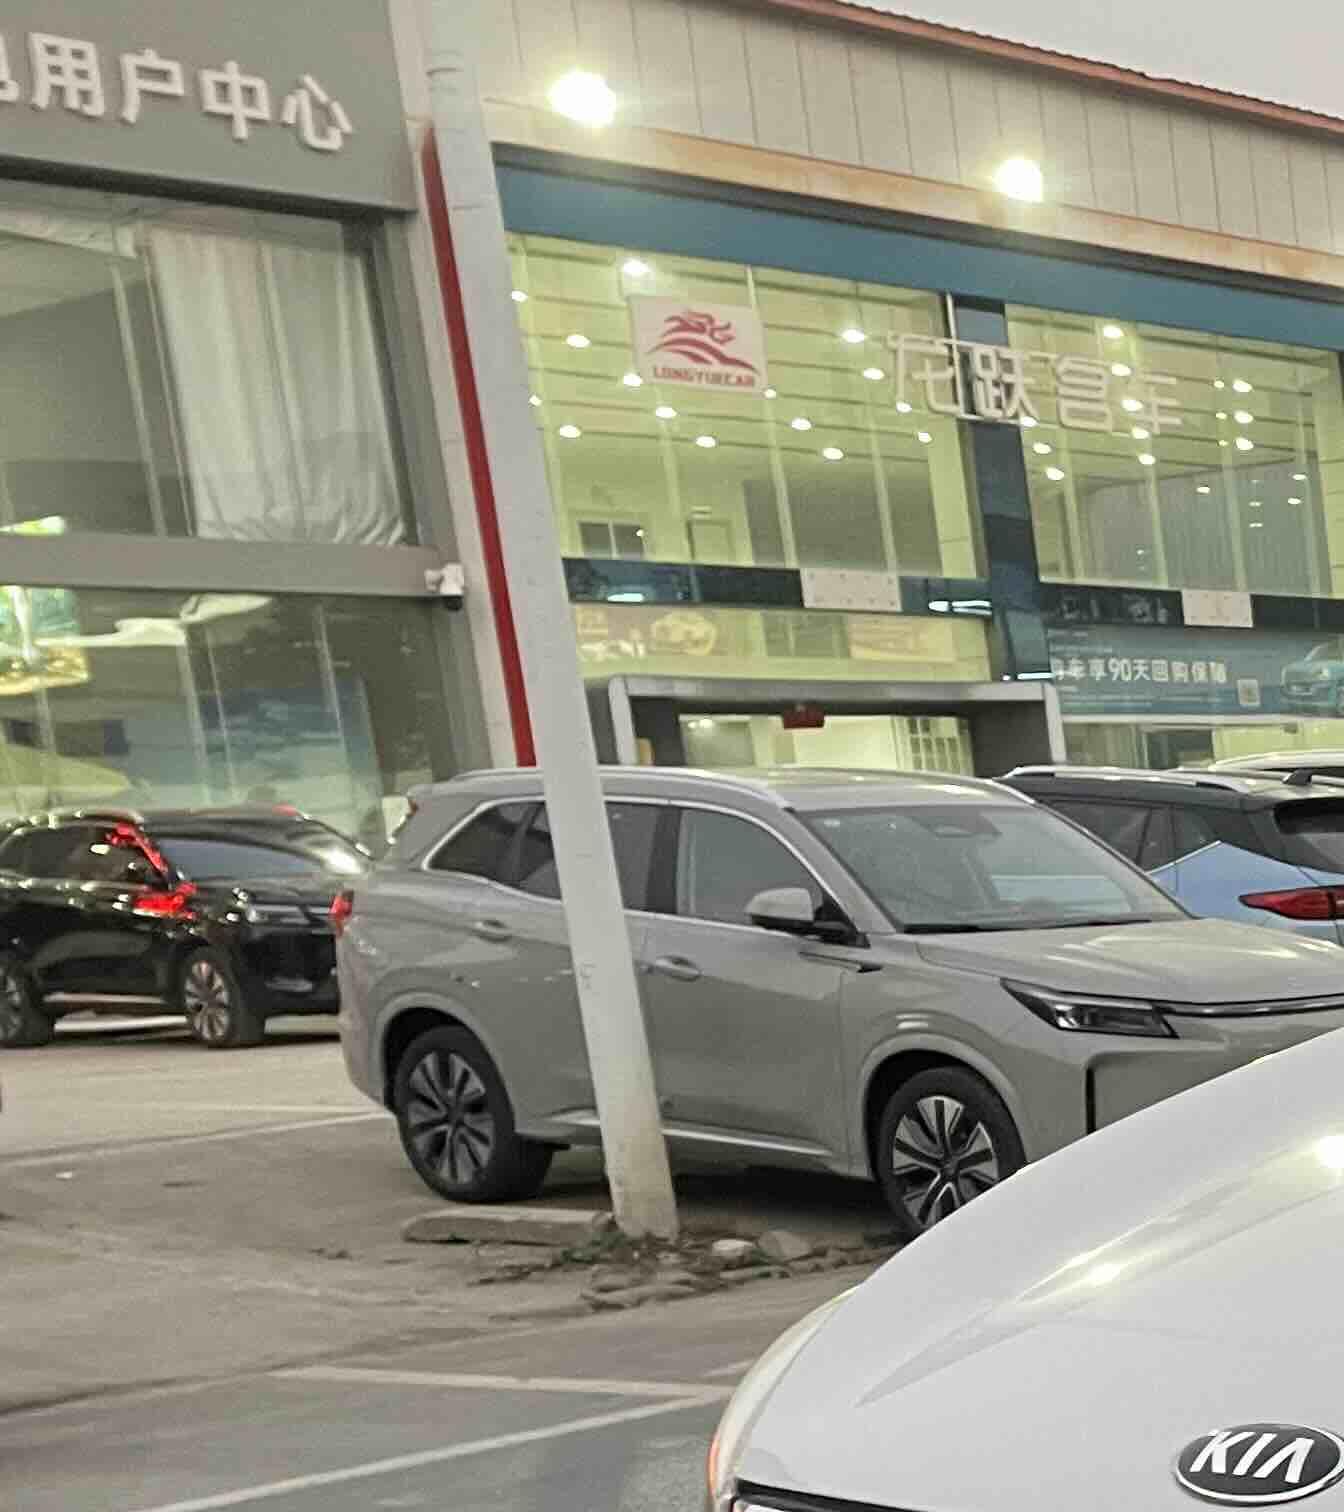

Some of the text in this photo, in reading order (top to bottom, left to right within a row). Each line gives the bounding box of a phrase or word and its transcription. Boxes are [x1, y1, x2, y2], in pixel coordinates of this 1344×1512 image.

[0, 31, 353, 151] 用户中心
[1189, 1429, 1315, 1484] KIA
